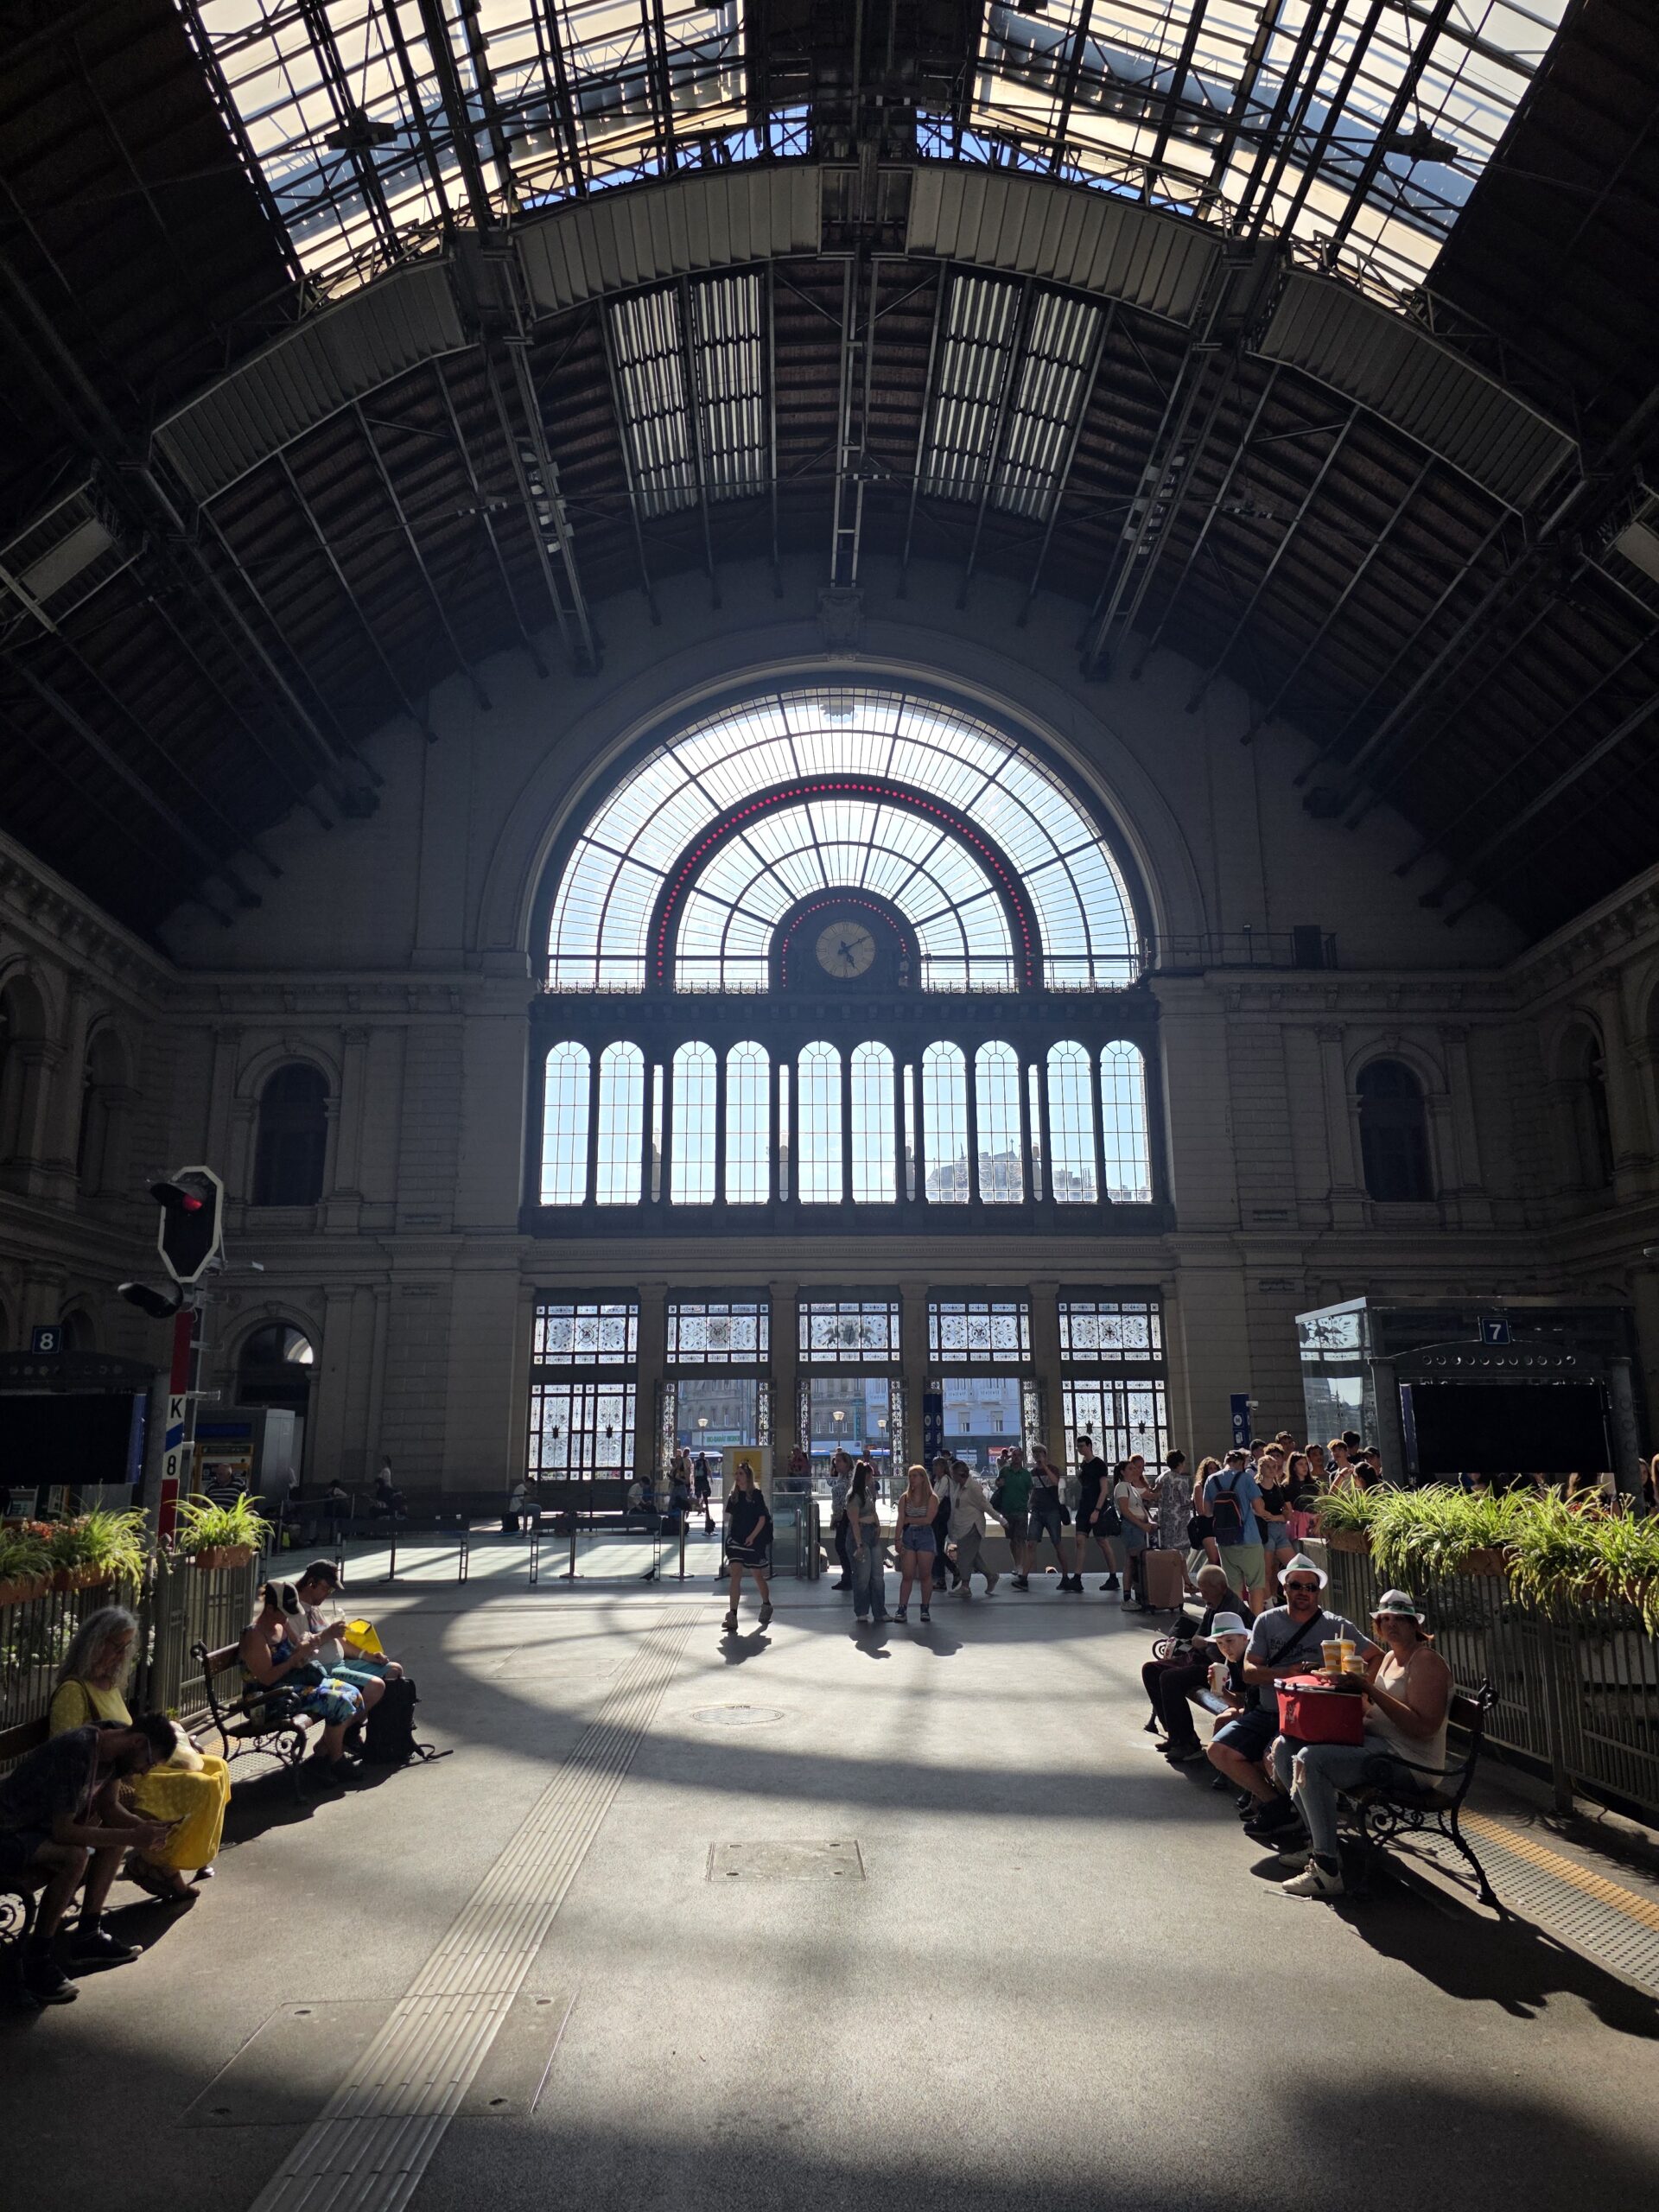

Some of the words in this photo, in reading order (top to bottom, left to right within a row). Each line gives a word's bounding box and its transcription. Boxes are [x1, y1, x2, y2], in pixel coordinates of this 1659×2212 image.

[40, 1332, 54, 1350] 8
[1489, 1324, 1502, 1340] 7
[171, 1398, 181, 1418] K
[167, 1455, 176, 1475] 8
